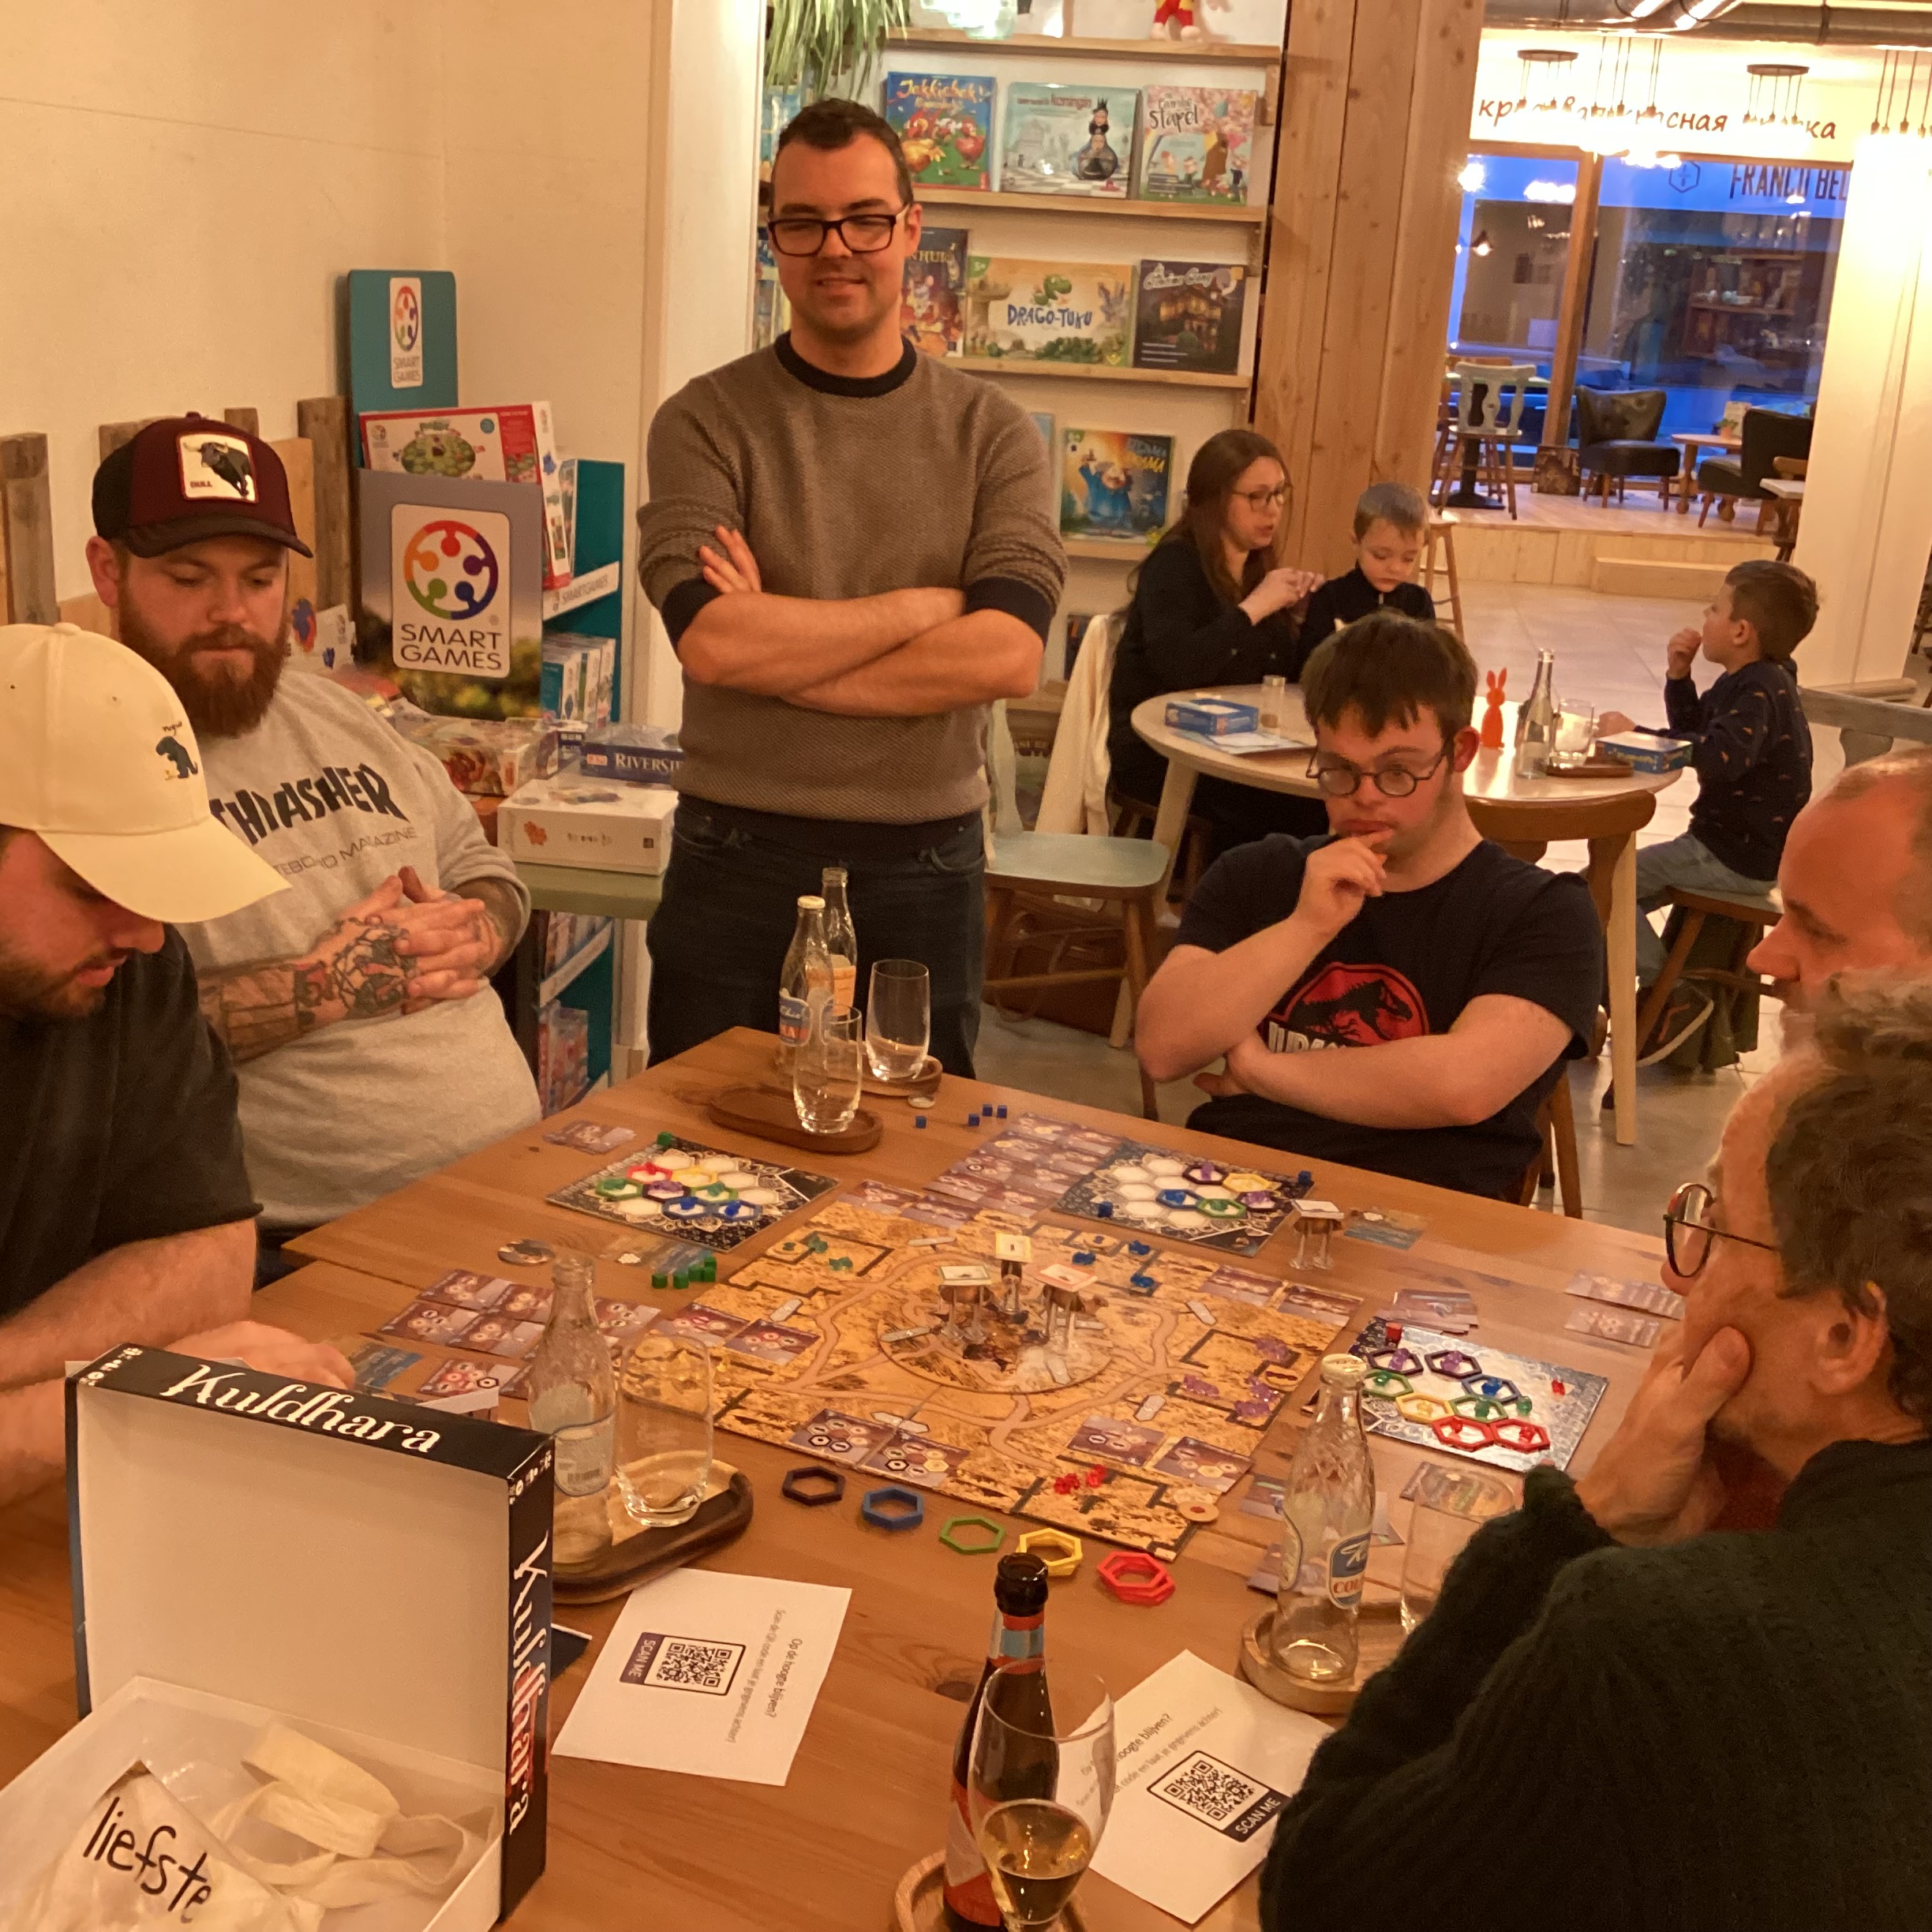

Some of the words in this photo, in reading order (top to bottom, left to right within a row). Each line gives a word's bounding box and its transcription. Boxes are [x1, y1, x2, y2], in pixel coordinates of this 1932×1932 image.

[1007, 304, 1093, 329] DRAGO-TUKU
[400, 623, 502, 650] SMART
[400, 643, 503, 671] GAMES
[159, 1364, 442, 1454] Kuldhara
[636, 1639, 657, 1663] SCAN
[508, 1529, 550, 1836] Kuldhara
[628, 1663, 646, 1678] ME
[1235, 1809, 1267, 1834] SCAN
[1260, 1796, 1282, 1813] ME
[83, 1795, 212, 1924] liefste
